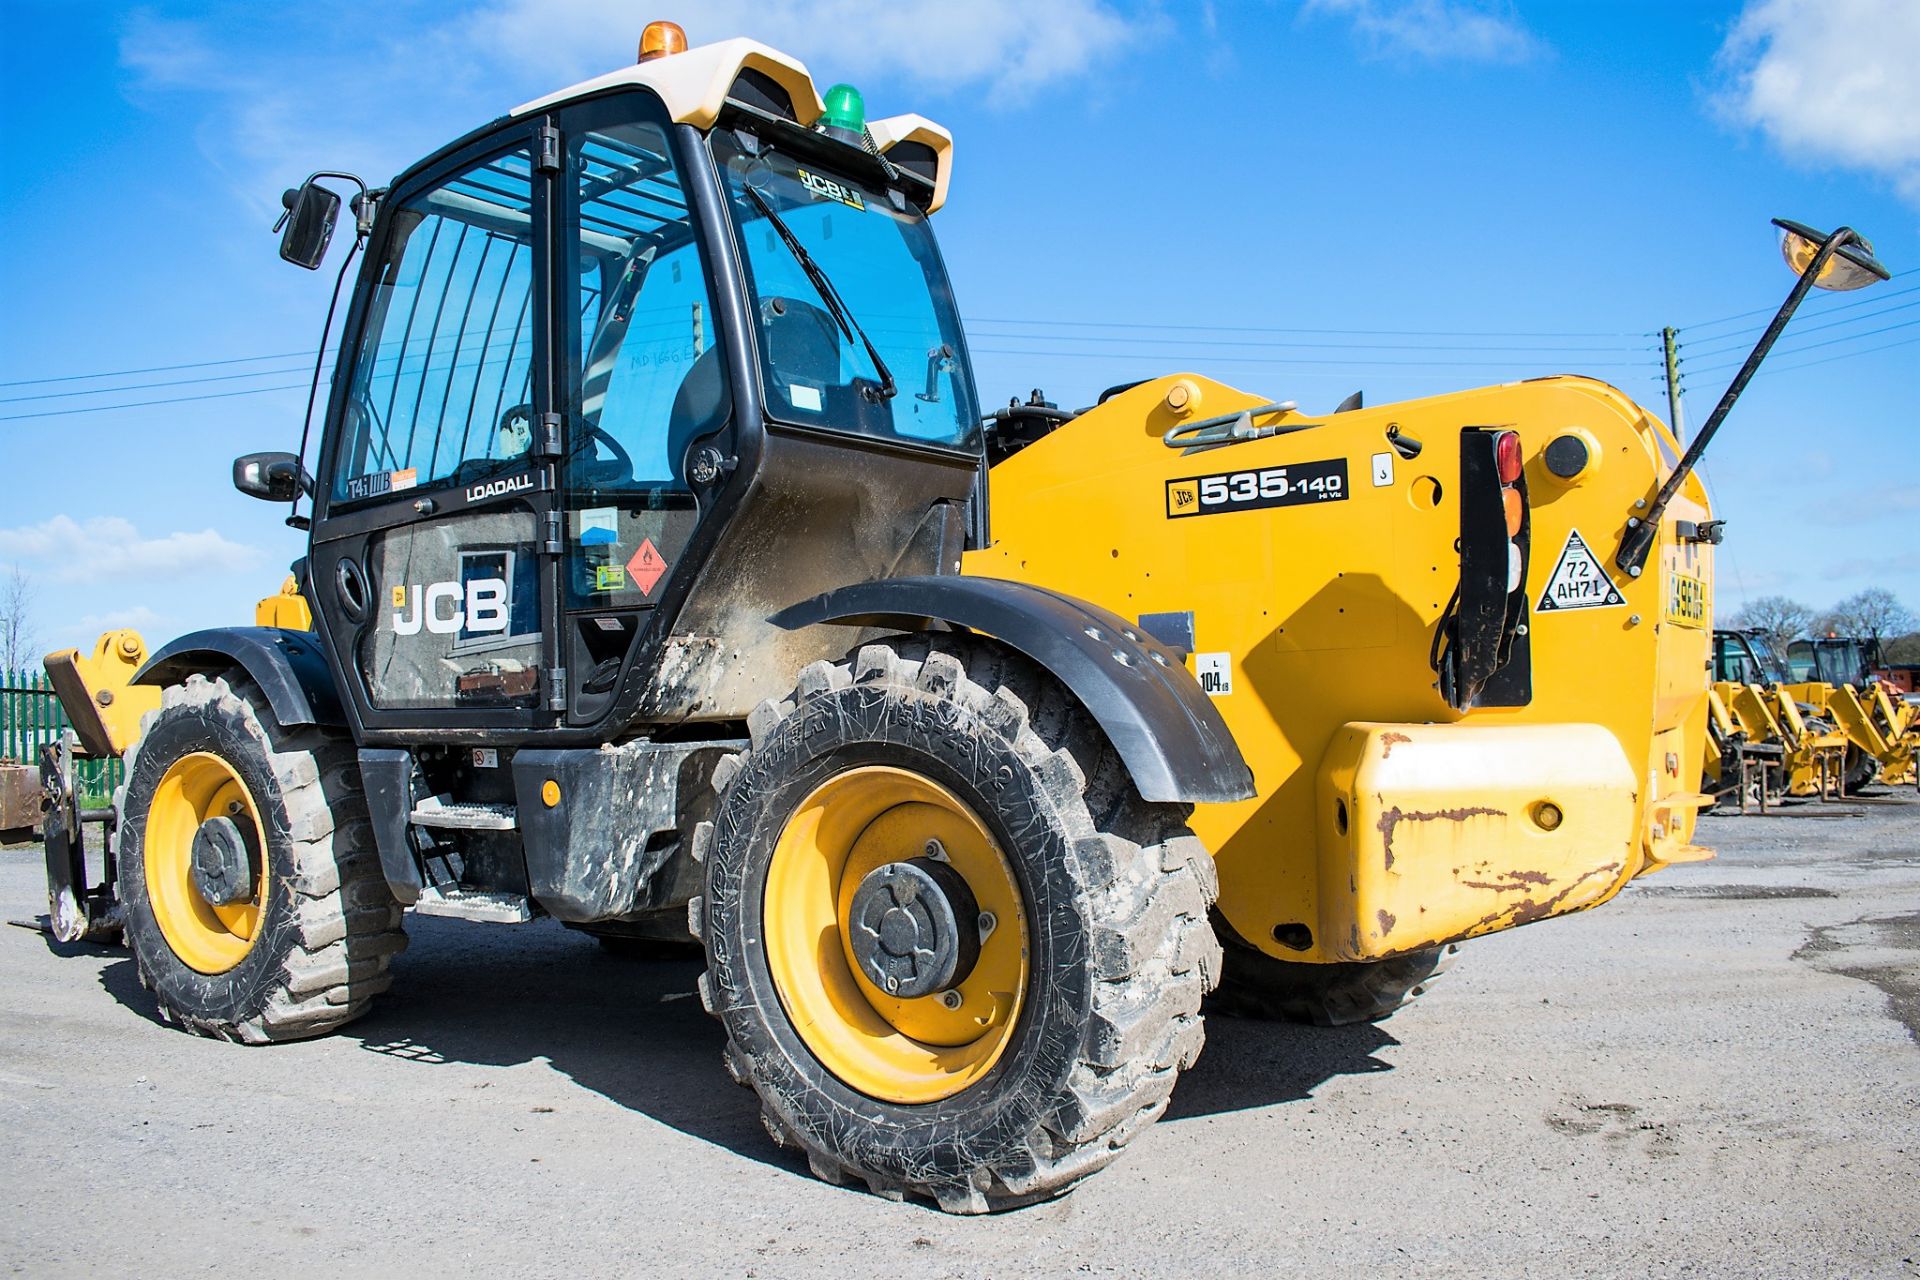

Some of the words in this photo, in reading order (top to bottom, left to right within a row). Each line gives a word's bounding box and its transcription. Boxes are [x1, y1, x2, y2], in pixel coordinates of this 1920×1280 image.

[800, 171, 843, 198] JCB
[465, 474, 534, 502] LOADALL
[1176, 488, 1194, 506] JCB
[1566, 561, 1589, 578] 72
[393, 579, 509, 636] JCB
[1200, 671, 1221, 692] 104
